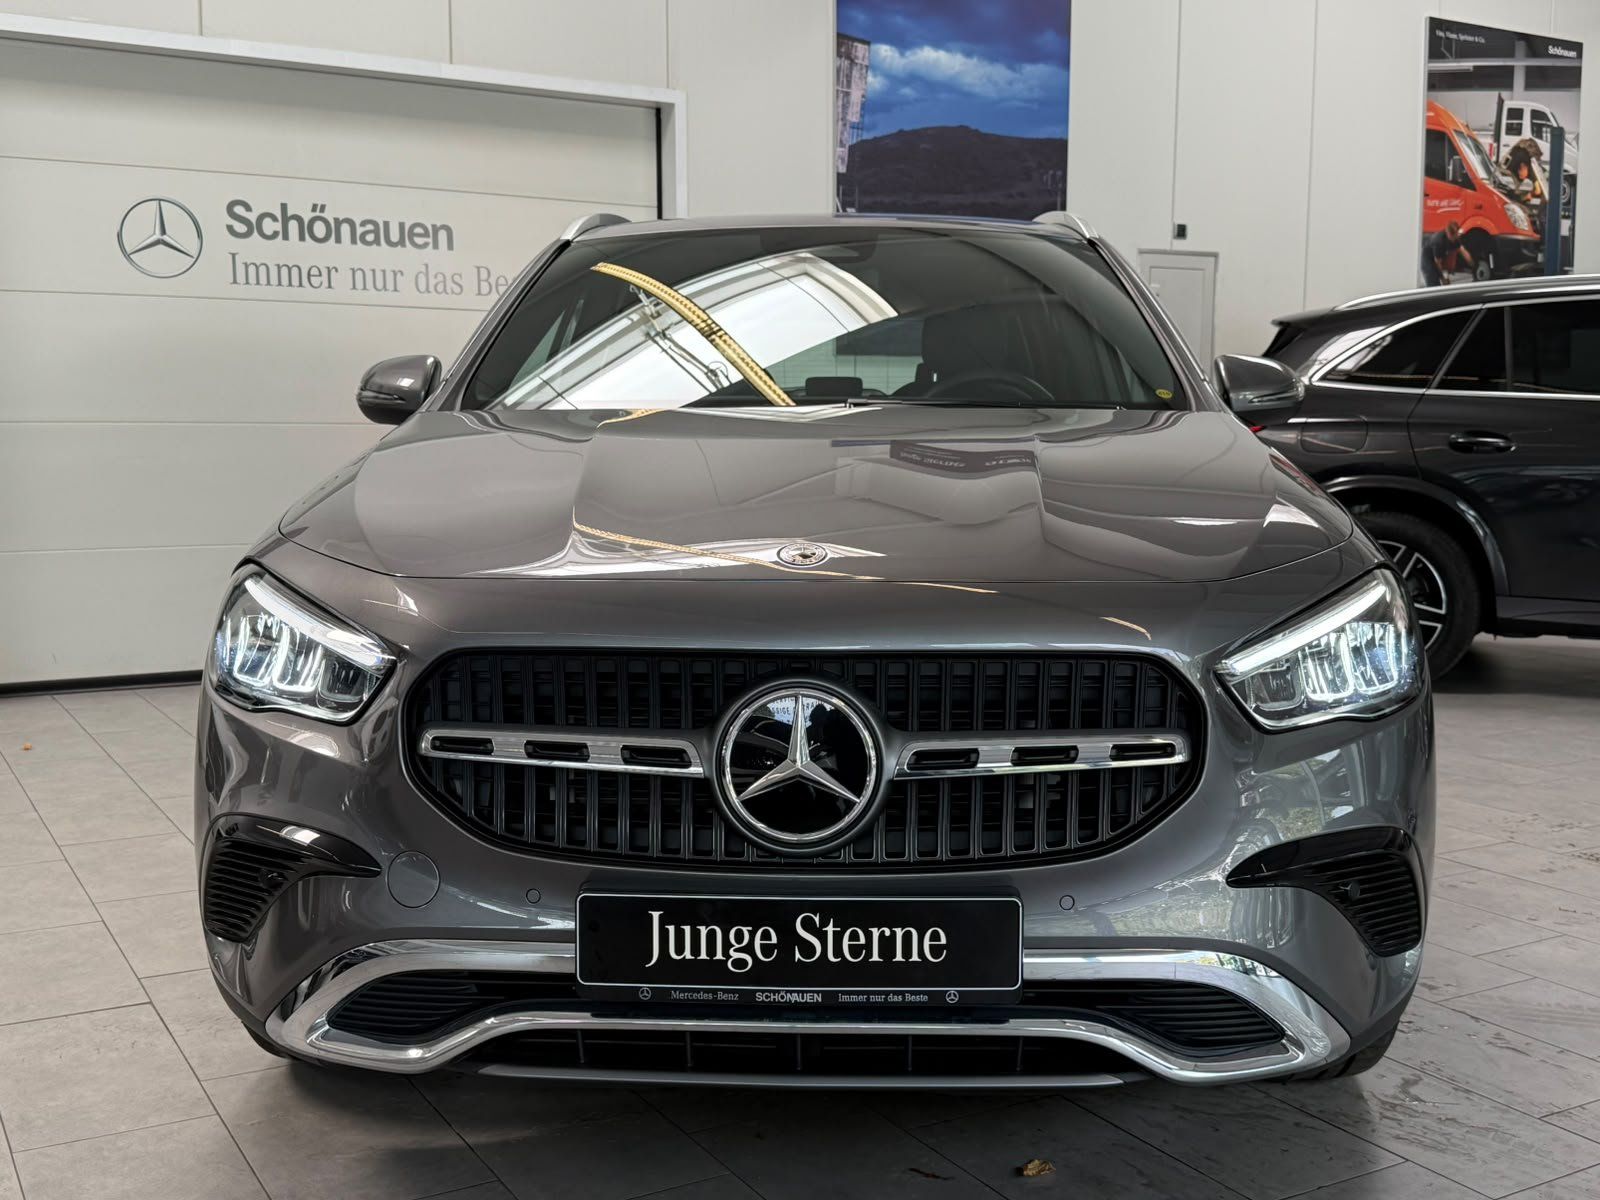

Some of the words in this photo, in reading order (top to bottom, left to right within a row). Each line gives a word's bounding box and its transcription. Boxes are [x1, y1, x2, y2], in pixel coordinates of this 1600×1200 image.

[225, 199, 454, 251] Schönauen
[228, 251, 339, 290] Immer
[349, 265, 404, 293] nur
[414, 263, 464, 296] das
[645, 910, 778, 973] Junge
[794, 912, 948, 963] Sterne
[671, 990, 739, 1001] Mercedes-Benz
[755, 990, 822, 1003] SCHÖNAUEN
[838, 993, 868, 1002] Immer
[869, 994, 886, 1003] nur
[887, 994, 903, 1003] das
[905, 994, 929, 1003] Beste
